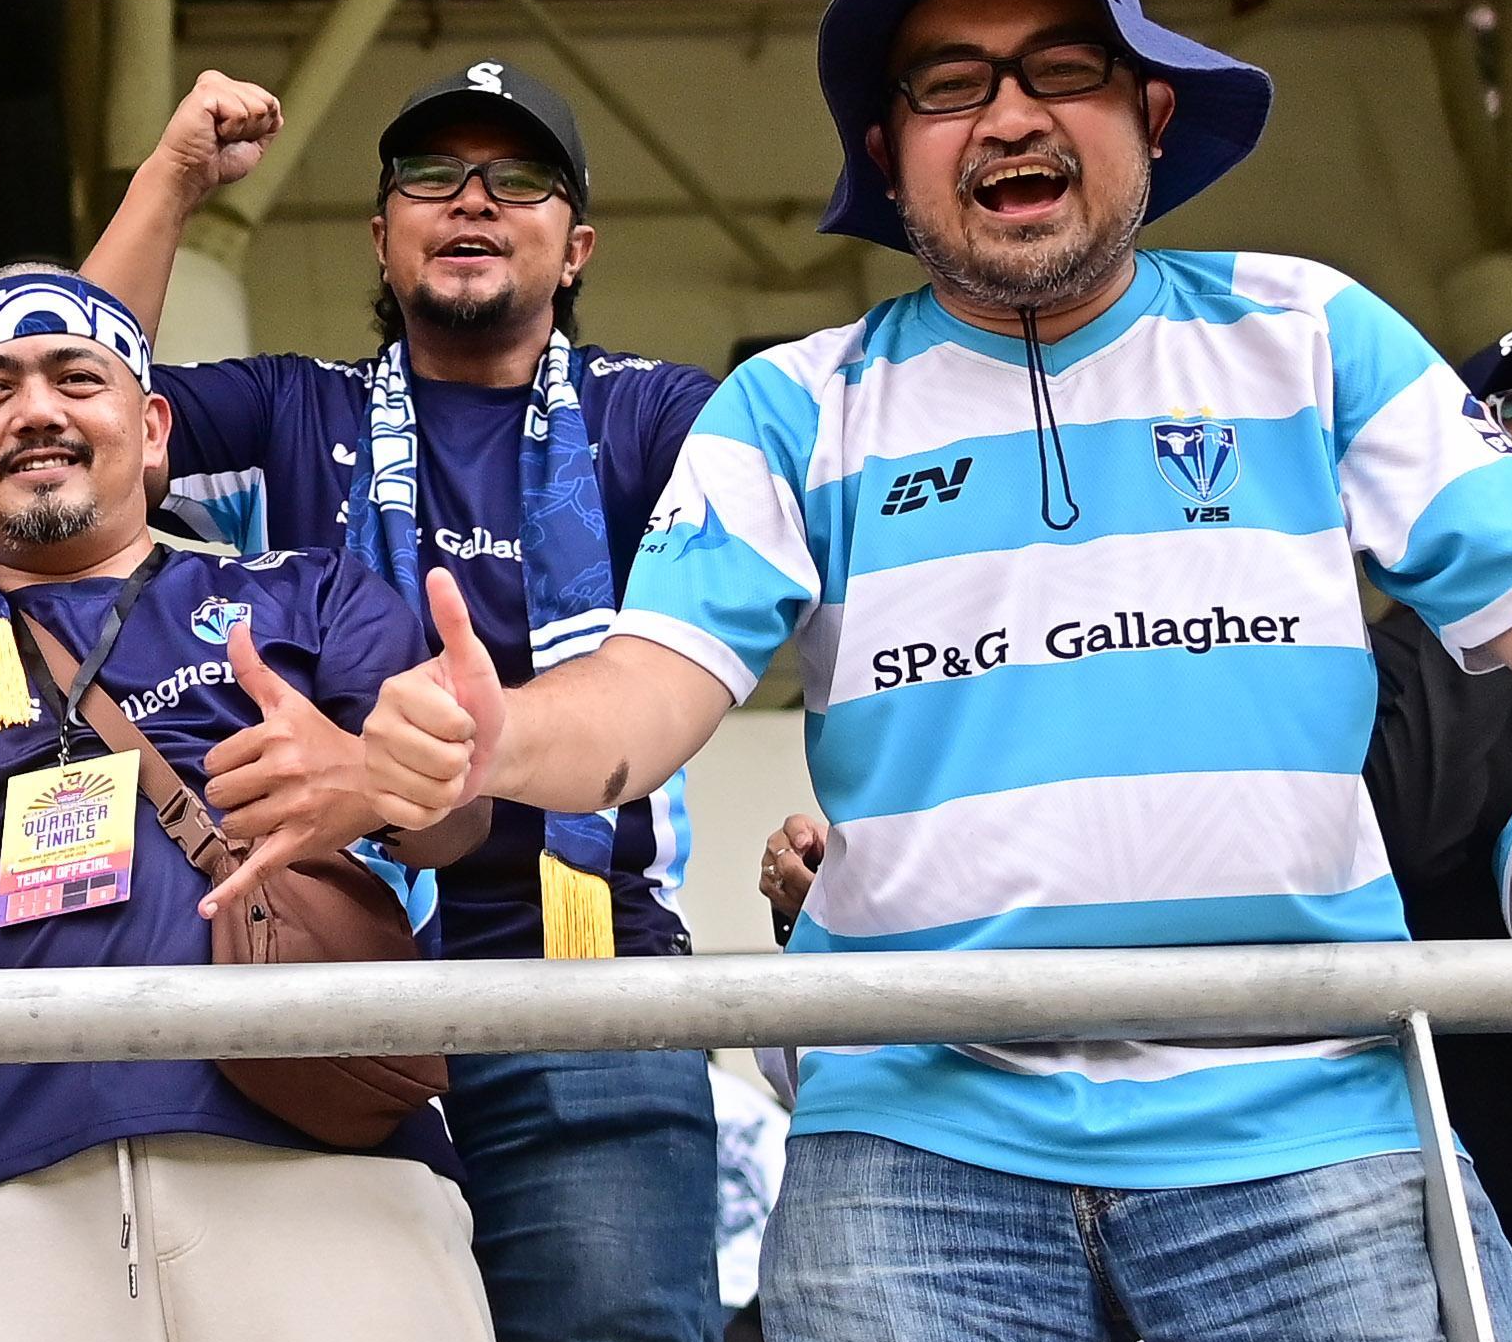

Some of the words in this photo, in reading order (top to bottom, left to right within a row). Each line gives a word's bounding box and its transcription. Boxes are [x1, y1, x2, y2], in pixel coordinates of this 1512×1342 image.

[1183, 507, 1230, 522] V25
[873, 628, 1010, 691] SP&G
[1045, 606, 1301, 658] Gallagher
[24, 804, 108, 837] QUARTER
[36, 824, 96, 851] FINALS
[16, 868, 53, 889] TEAM
[56, 856, 113, 880] OFFICIAL
